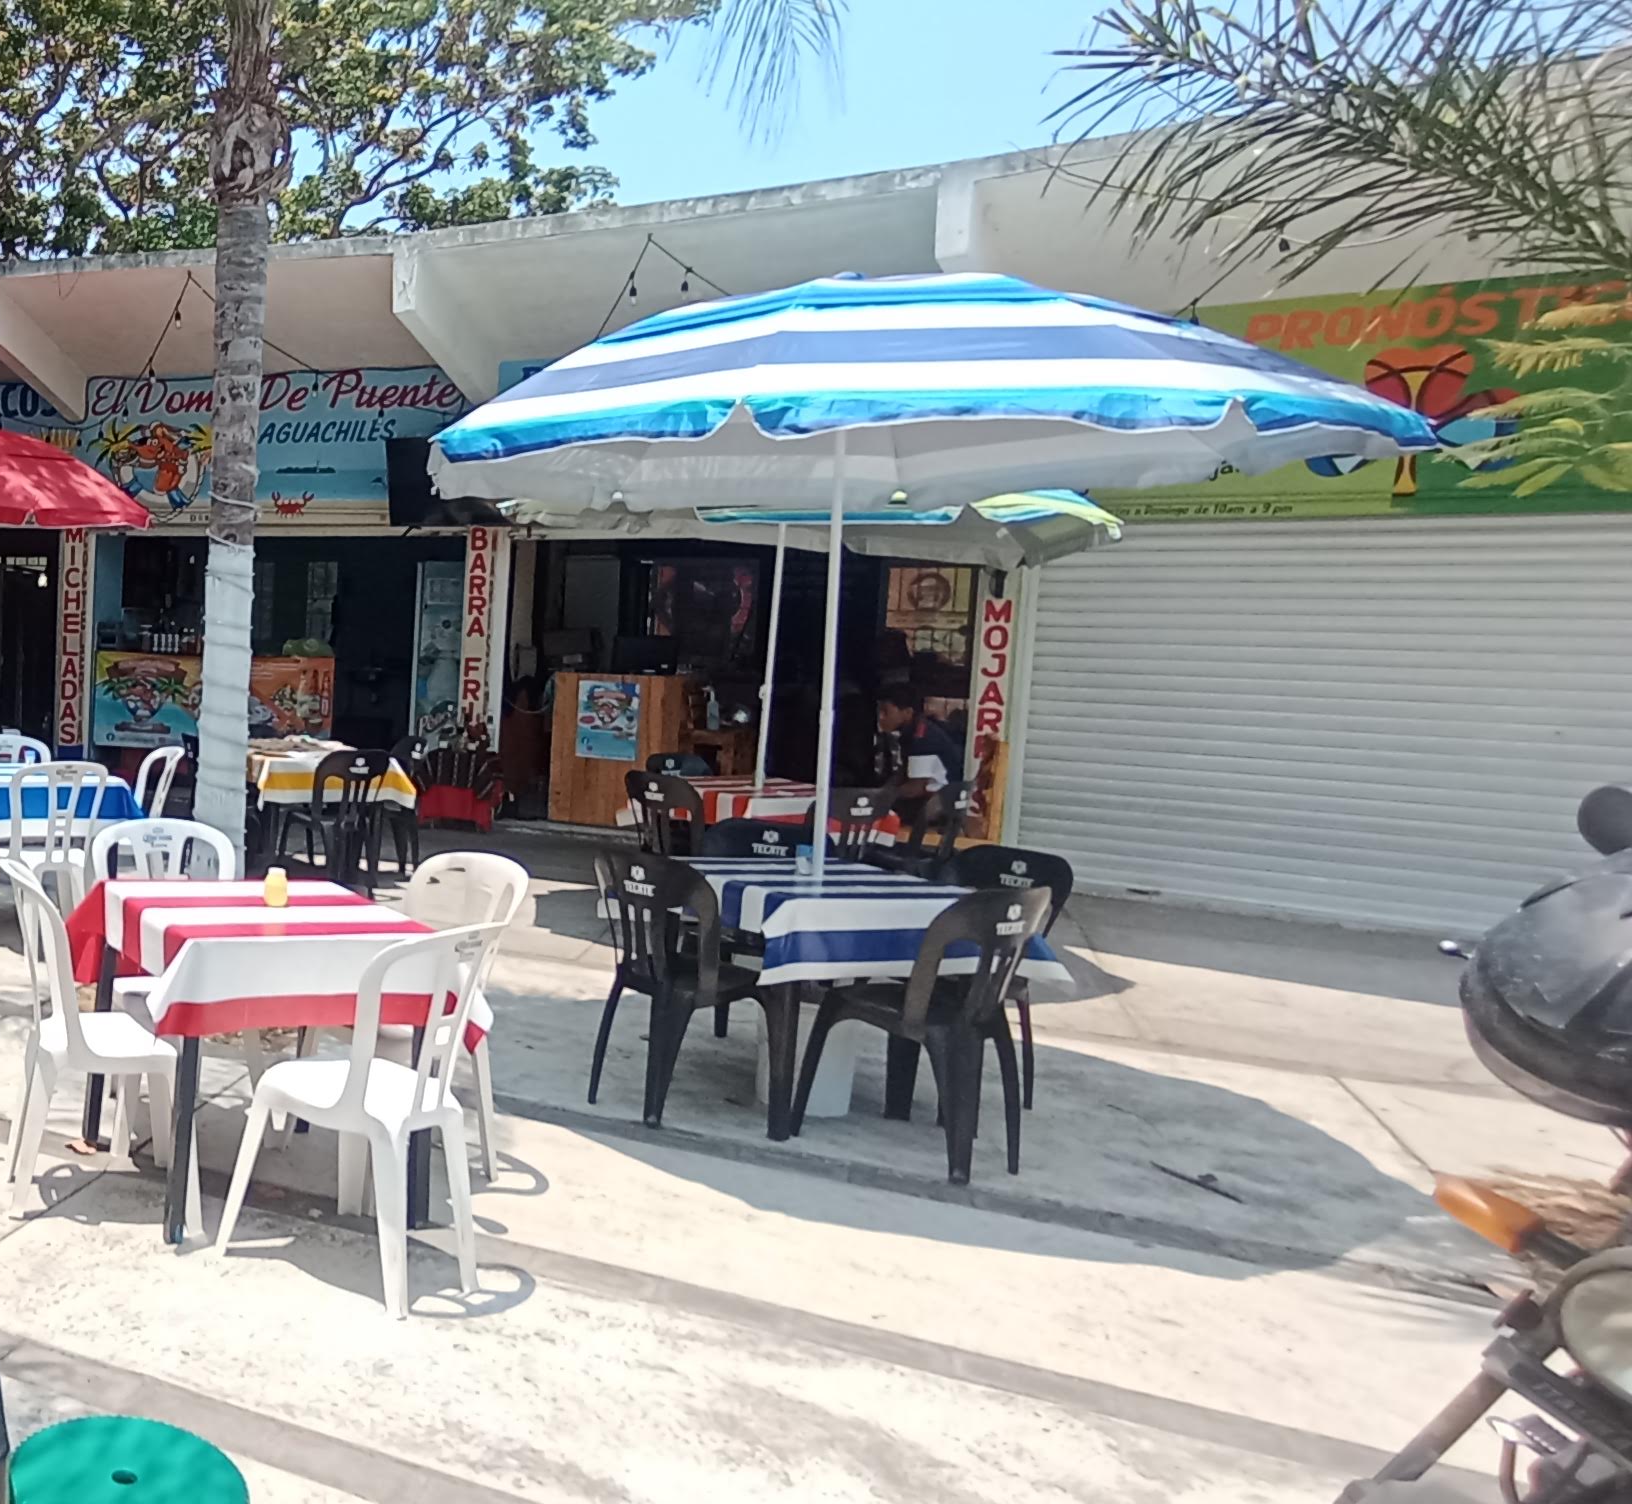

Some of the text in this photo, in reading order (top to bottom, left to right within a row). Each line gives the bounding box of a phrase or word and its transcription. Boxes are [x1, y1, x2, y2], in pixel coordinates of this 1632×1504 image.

[91, 368, 459, 416] El Dom De Puente
[257, 418, 397, 445] AGUACHILES
[467, 527, 489, 638] BARRA
[60, 528, 83, 744] MICHELADAS
